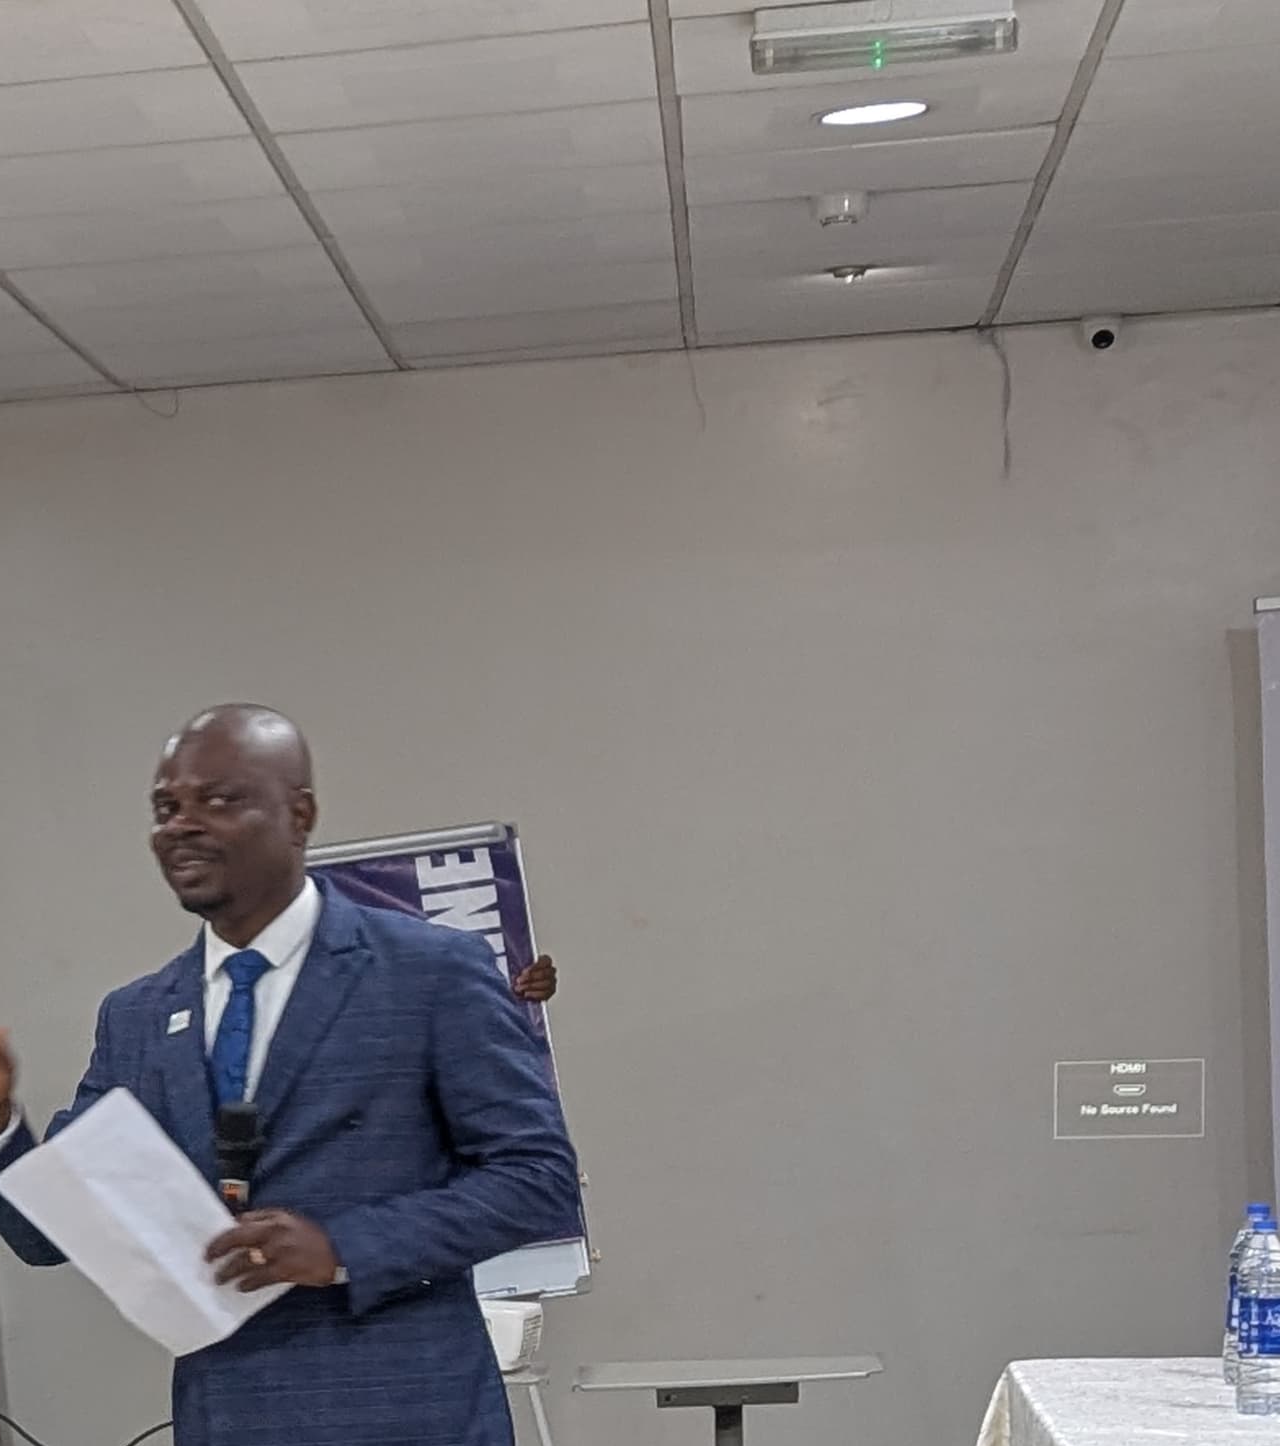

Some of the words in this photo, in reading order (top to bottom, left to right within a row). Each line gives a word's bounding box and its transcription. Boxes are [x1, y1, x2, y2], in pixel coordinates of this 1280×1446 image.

[1080, 1104, 1097, 1115] No
[1100, 1103, 1139, 1115] Source
[1142, 1102, 1178, 1114] Found
